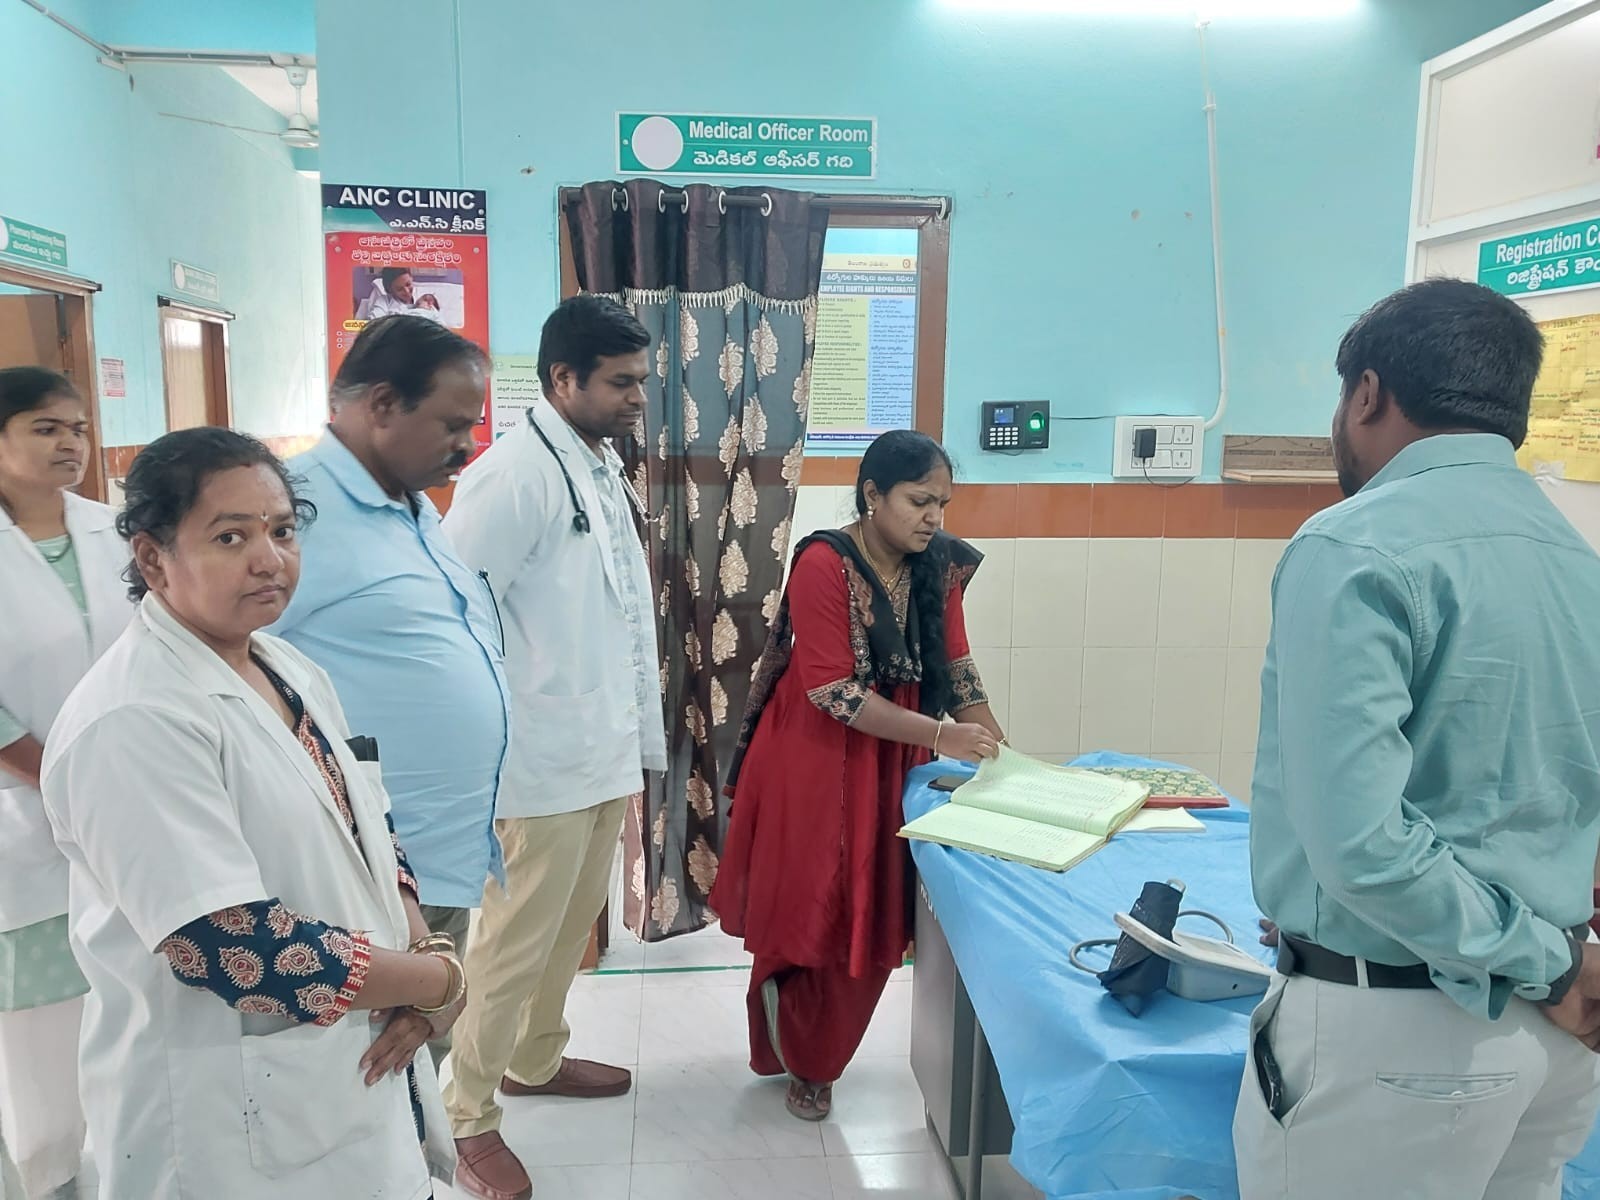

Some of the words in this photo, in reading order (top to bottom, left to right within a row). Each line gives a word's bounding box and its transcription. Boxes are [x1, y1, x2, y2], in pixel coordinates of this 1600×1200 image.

[689, 120, 752, 140] Medical
[757, 122, 814, 141] Officer
[819, 124, 868, 142] Room
[693, 150, 757, 166] మెడికల్
[763, 150, 820, 169] ఆఫీసర్
[826, 155, 853, 168] గది
[339, 187, 390, 207] ANC
[397, 189, 475, 210] CLINIC
[1496, 231, 1581, 265] Registration
[1586, 224, 1600, 247] C
